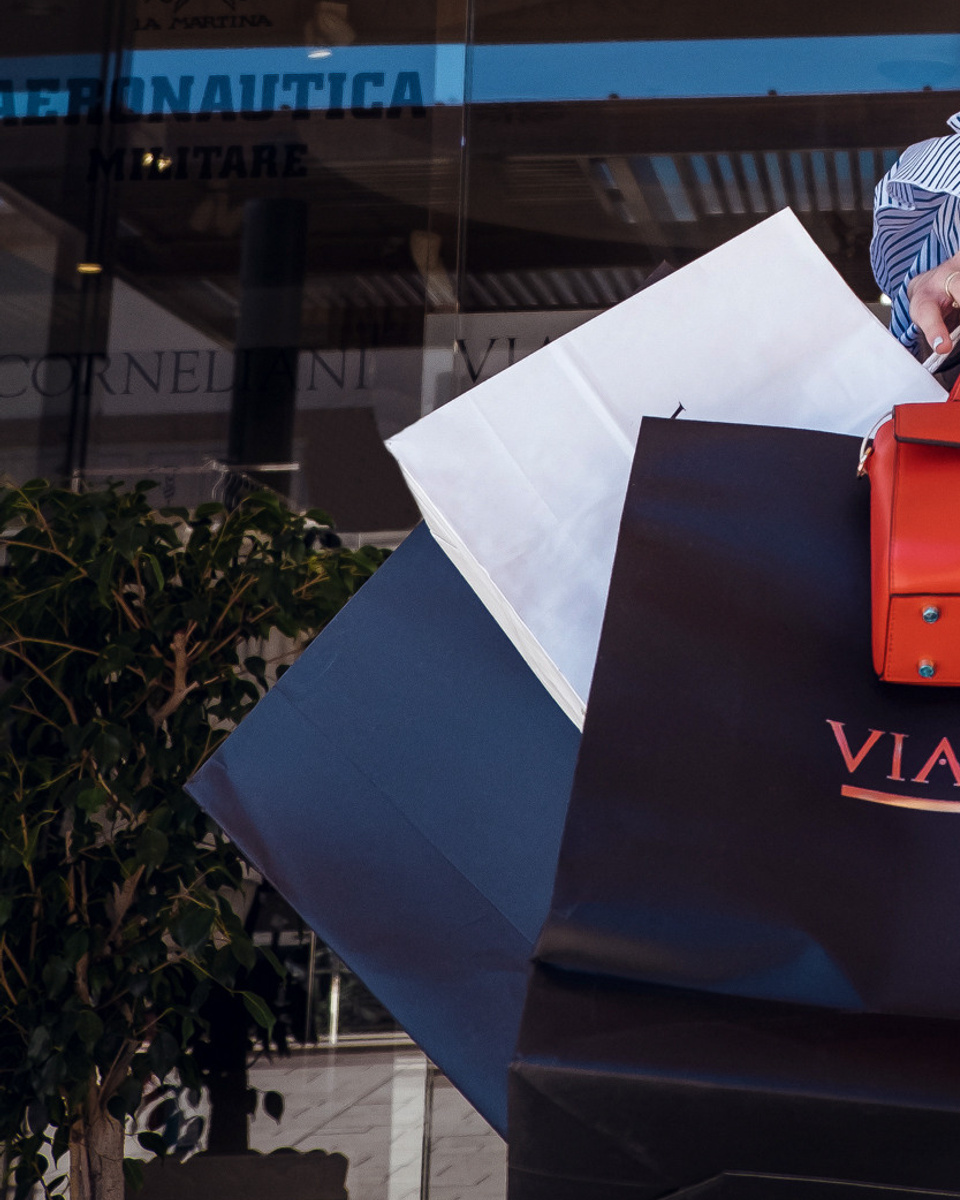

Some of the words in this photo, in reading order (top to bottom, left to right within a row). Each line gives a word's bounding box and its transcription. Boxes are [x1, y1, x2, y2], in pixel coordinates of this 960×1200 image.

[131, 17, 162, 32] LA
[168, 14, 273, 31] MARTINA
[0, 71, 427, 126] AERONAUTICA
[87, 143, 308, 183] MILITARE
[0, 348, 370, 399] CORNELIANI
[457, 335, 551, 383] VI
